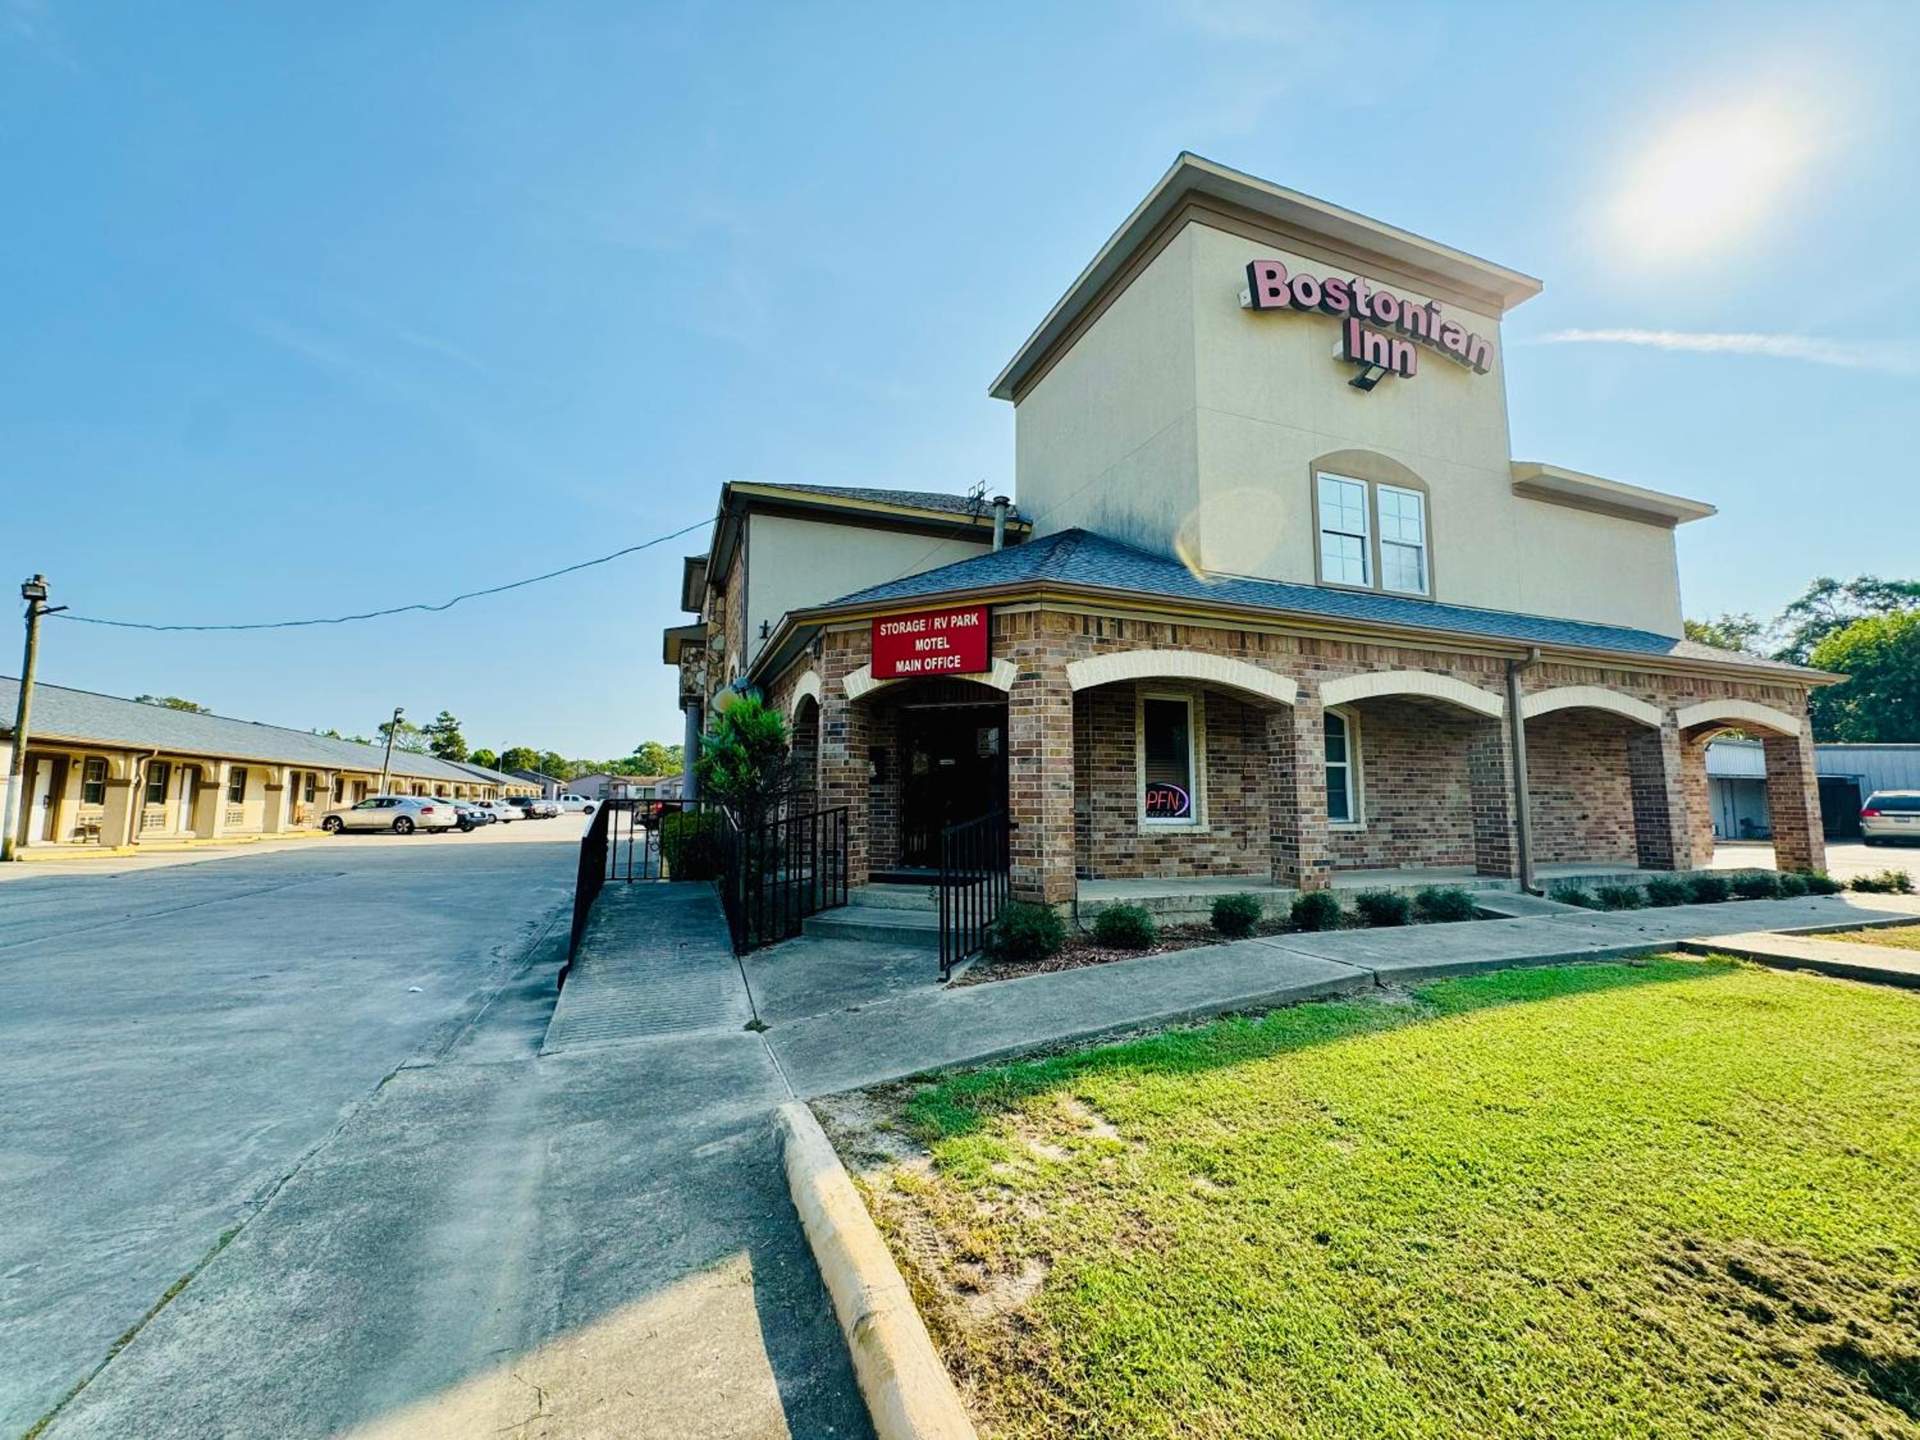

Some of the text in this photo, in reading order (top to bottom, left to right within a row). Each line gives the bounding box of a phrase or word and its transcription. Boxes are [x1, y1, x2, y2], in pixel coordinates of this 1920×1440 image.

[1249, 259, 1494, 374] Bostonian
[1345, 317, 1417, 378] Inn
[880, 619, 926, 636] STORAGE
[934, 616, 948, 630] RV
[950, 612, 979, 628] PARK
[915, 636, 950, 652] MOTEL
[895, 655, 961, 673] MAIN OFFICE
